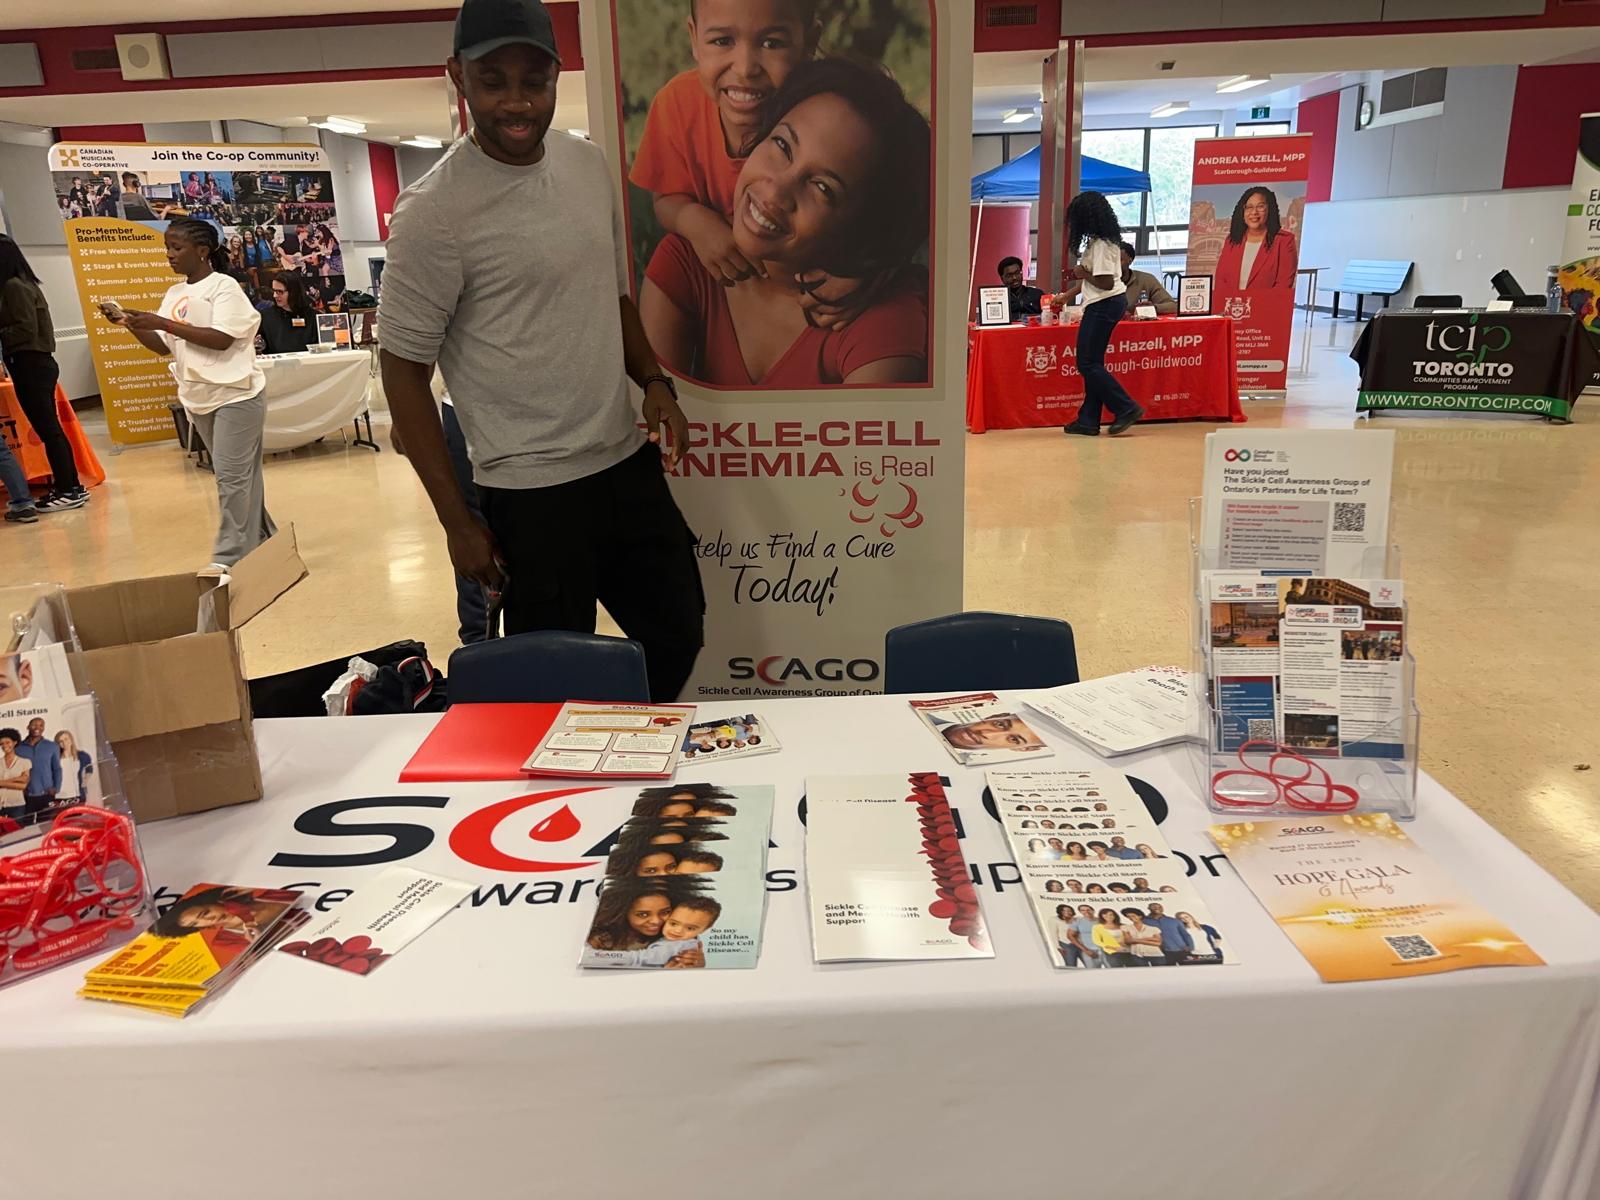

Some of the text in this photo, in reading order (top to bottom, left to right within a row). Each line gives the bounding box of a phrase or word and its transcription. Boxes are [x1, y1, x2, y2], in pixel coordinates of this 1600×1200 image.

[152, 150, 320, 162] Join the Co-op Community!
[1198, 153, 1305, 165] ANDREA HAZELL, MPP
[1214, 166, 1286, 176] Scarborough-Guildwood
[1120, 337, 1167, 352] Hazell,
[1171, 335, 1203, 348] MPP
[1413, 362, 1514, 377] TORONTO
[1364, 394, 1552, 412] WWW.TORONTOCIP.COM
[854, 457, 873, 476] is
[881, 455, 934, 477] Real
[1263, 468, 1289, 476] joined
[1262, 486, 1296, 494] Partners
[740, 541, 759, 559] us
[767, 530, 818, 558] Find
[823, 542, 835, 558] a
[846, 535, 896, 559] Cure
[729, 559, 839, 616] Today!
[728, 656, 880, 686] SCAGO
[698, 687, 730, 695] Sickle
[732, 687, 751, 696] Cell
[754, 688, 813, 697] Awareness
[16, 708, 48, 716] Status
[1282, 826, 1324, 834] SCAGO
[1273, 865, 1412, 886] HOPE GALA
[420, 882, 443, 897] Sickle
[367, 880, 432, 929] and Mental Health
[405, 898, 421, 910] Cell
[375, 910, 406, 932] Disease
